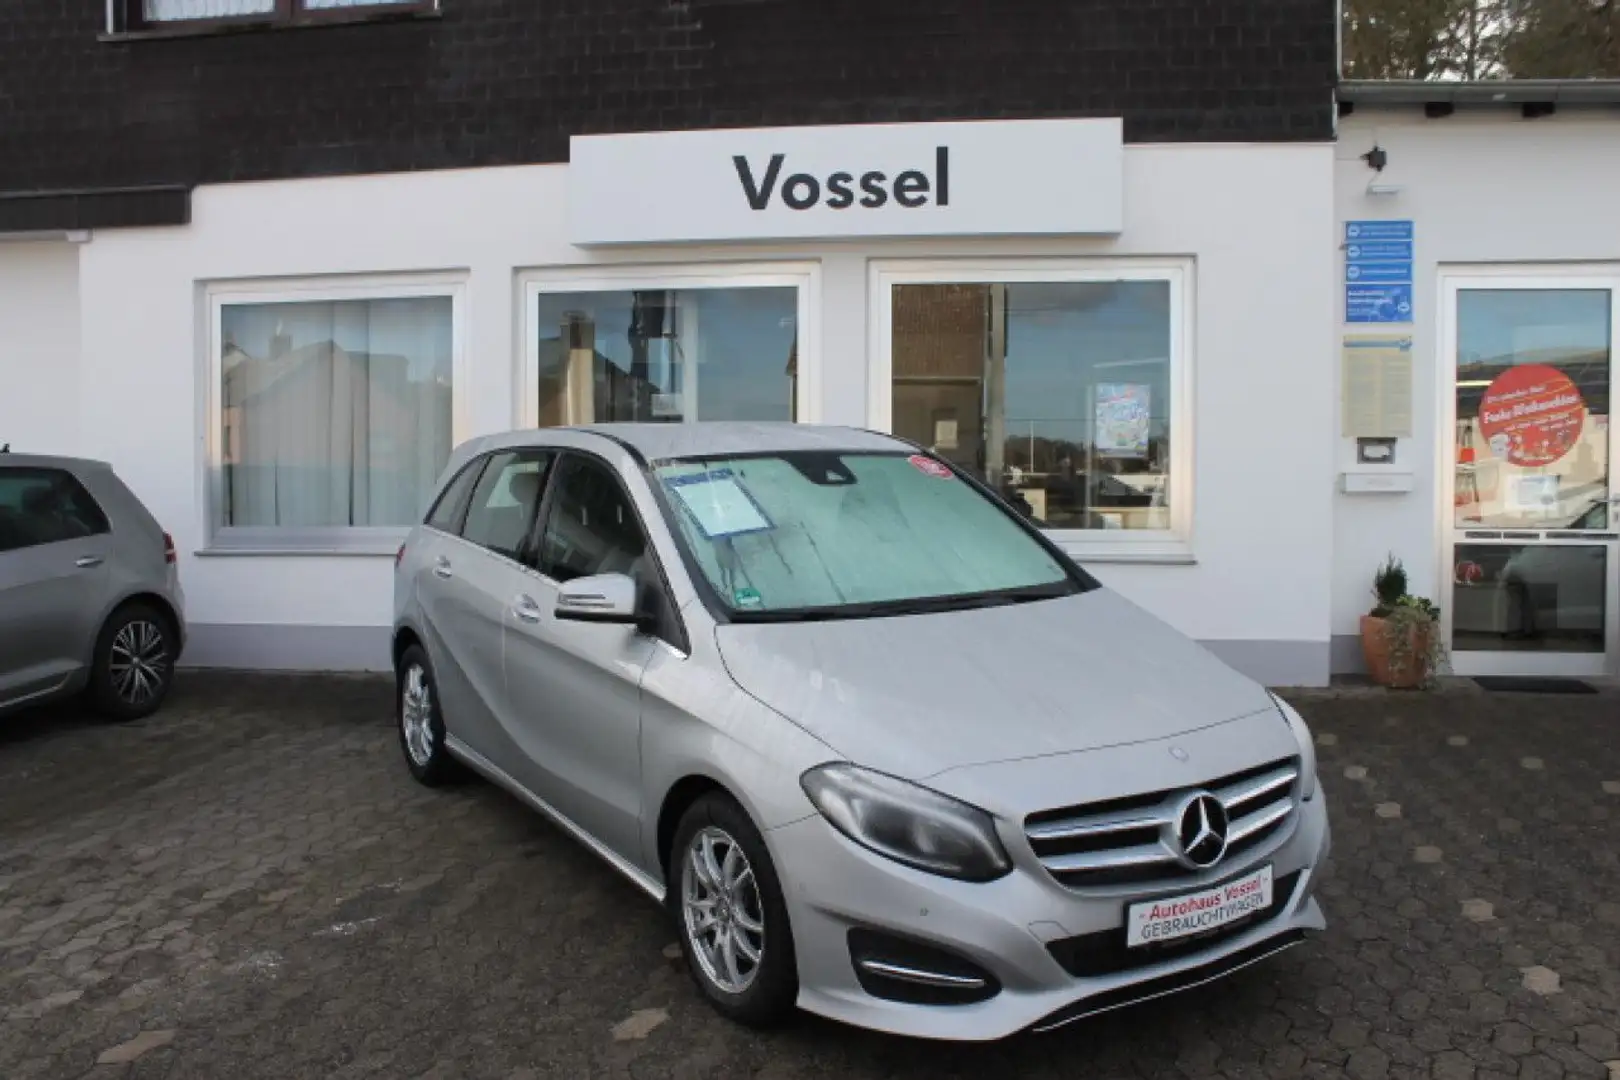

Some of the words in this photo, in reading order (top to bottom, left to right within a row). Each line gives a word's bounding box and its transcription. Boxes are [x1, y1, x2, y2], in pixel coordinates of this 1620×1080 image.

[732, 146, 949, 210] Vossel
[1140, 892, 1264, 940] GEBRAUCHTWAGEN
[1149, 892, 1222, 921] Autohaus
[1223, 874, 1262, 901] Vossel
